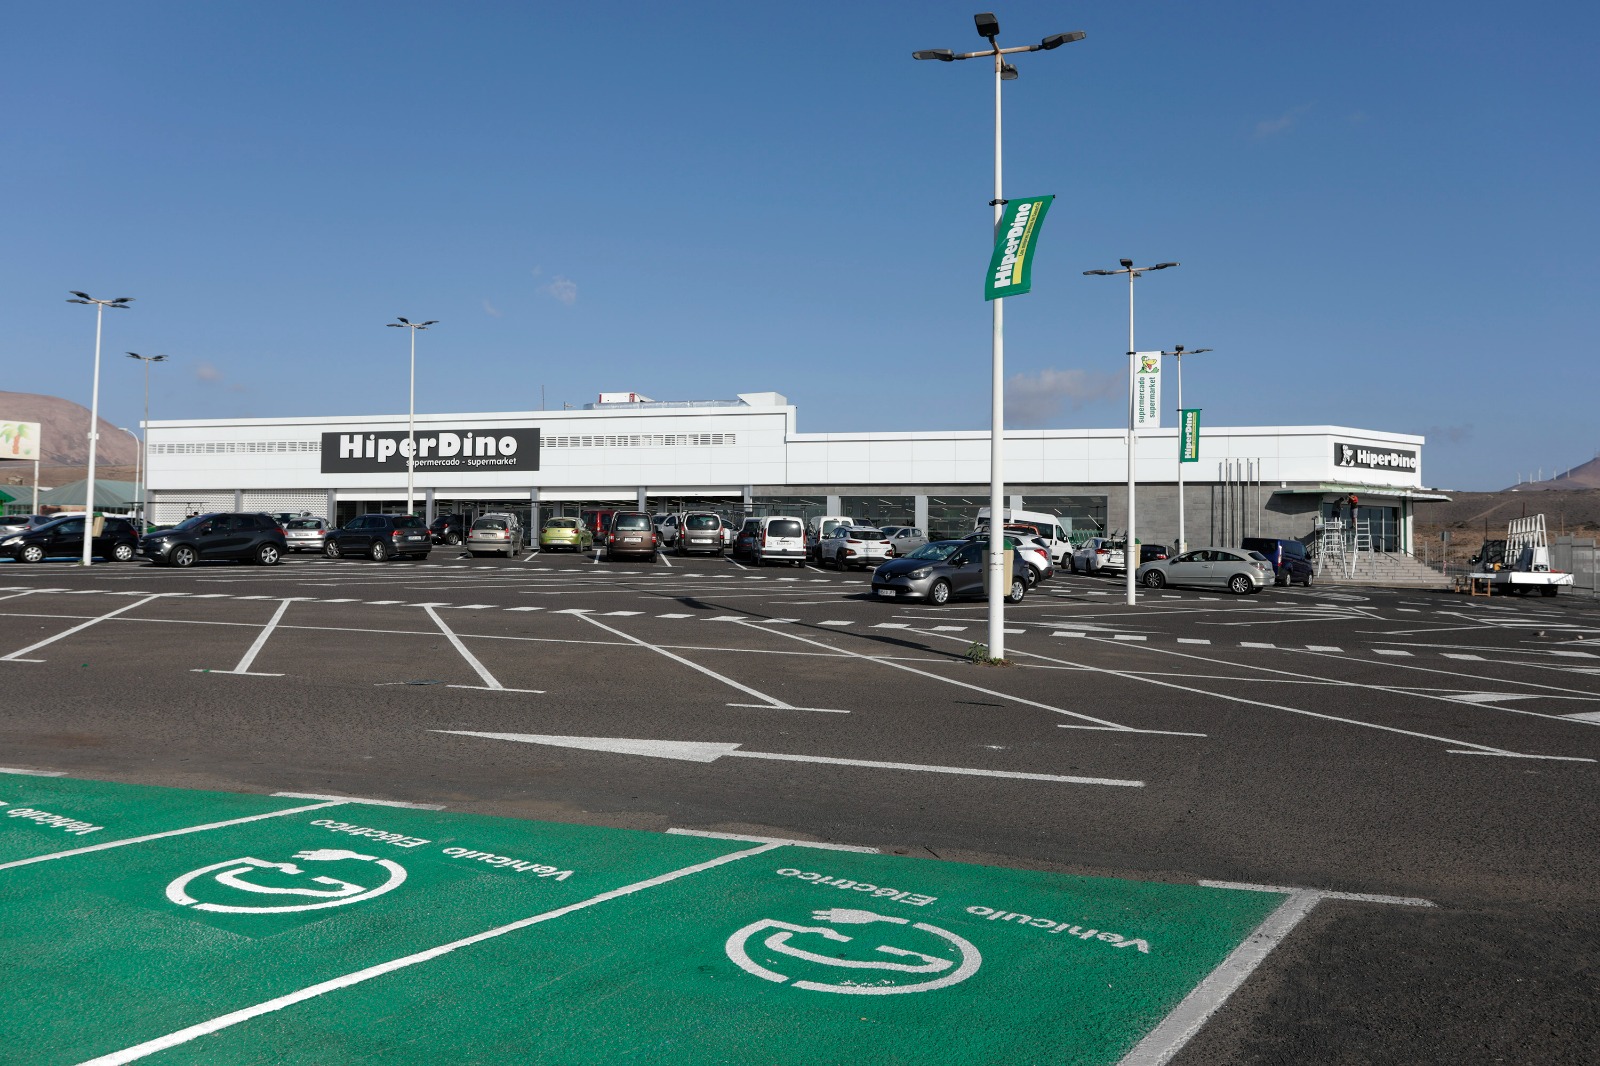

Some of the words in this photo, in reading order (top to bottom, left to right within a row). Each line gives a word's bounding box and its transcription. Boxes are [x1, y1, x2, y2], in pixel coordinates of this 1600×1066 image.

[994, 203, 1032, 288] HiperDino
[339, 432, 518, 463] HiperDino
[1184, 412, 1193, 459] HiperDino
[467, 457, 517, 467] supermarket
[1357, 449, 1417, 468] HiperDino
[309, 818, 431, 848] Eléctrico
[442, 846, 575, 882] Vehículo
[776, 867, 938, 906] Eléctrico
[966, 905, 1151, 954] Vehículo
